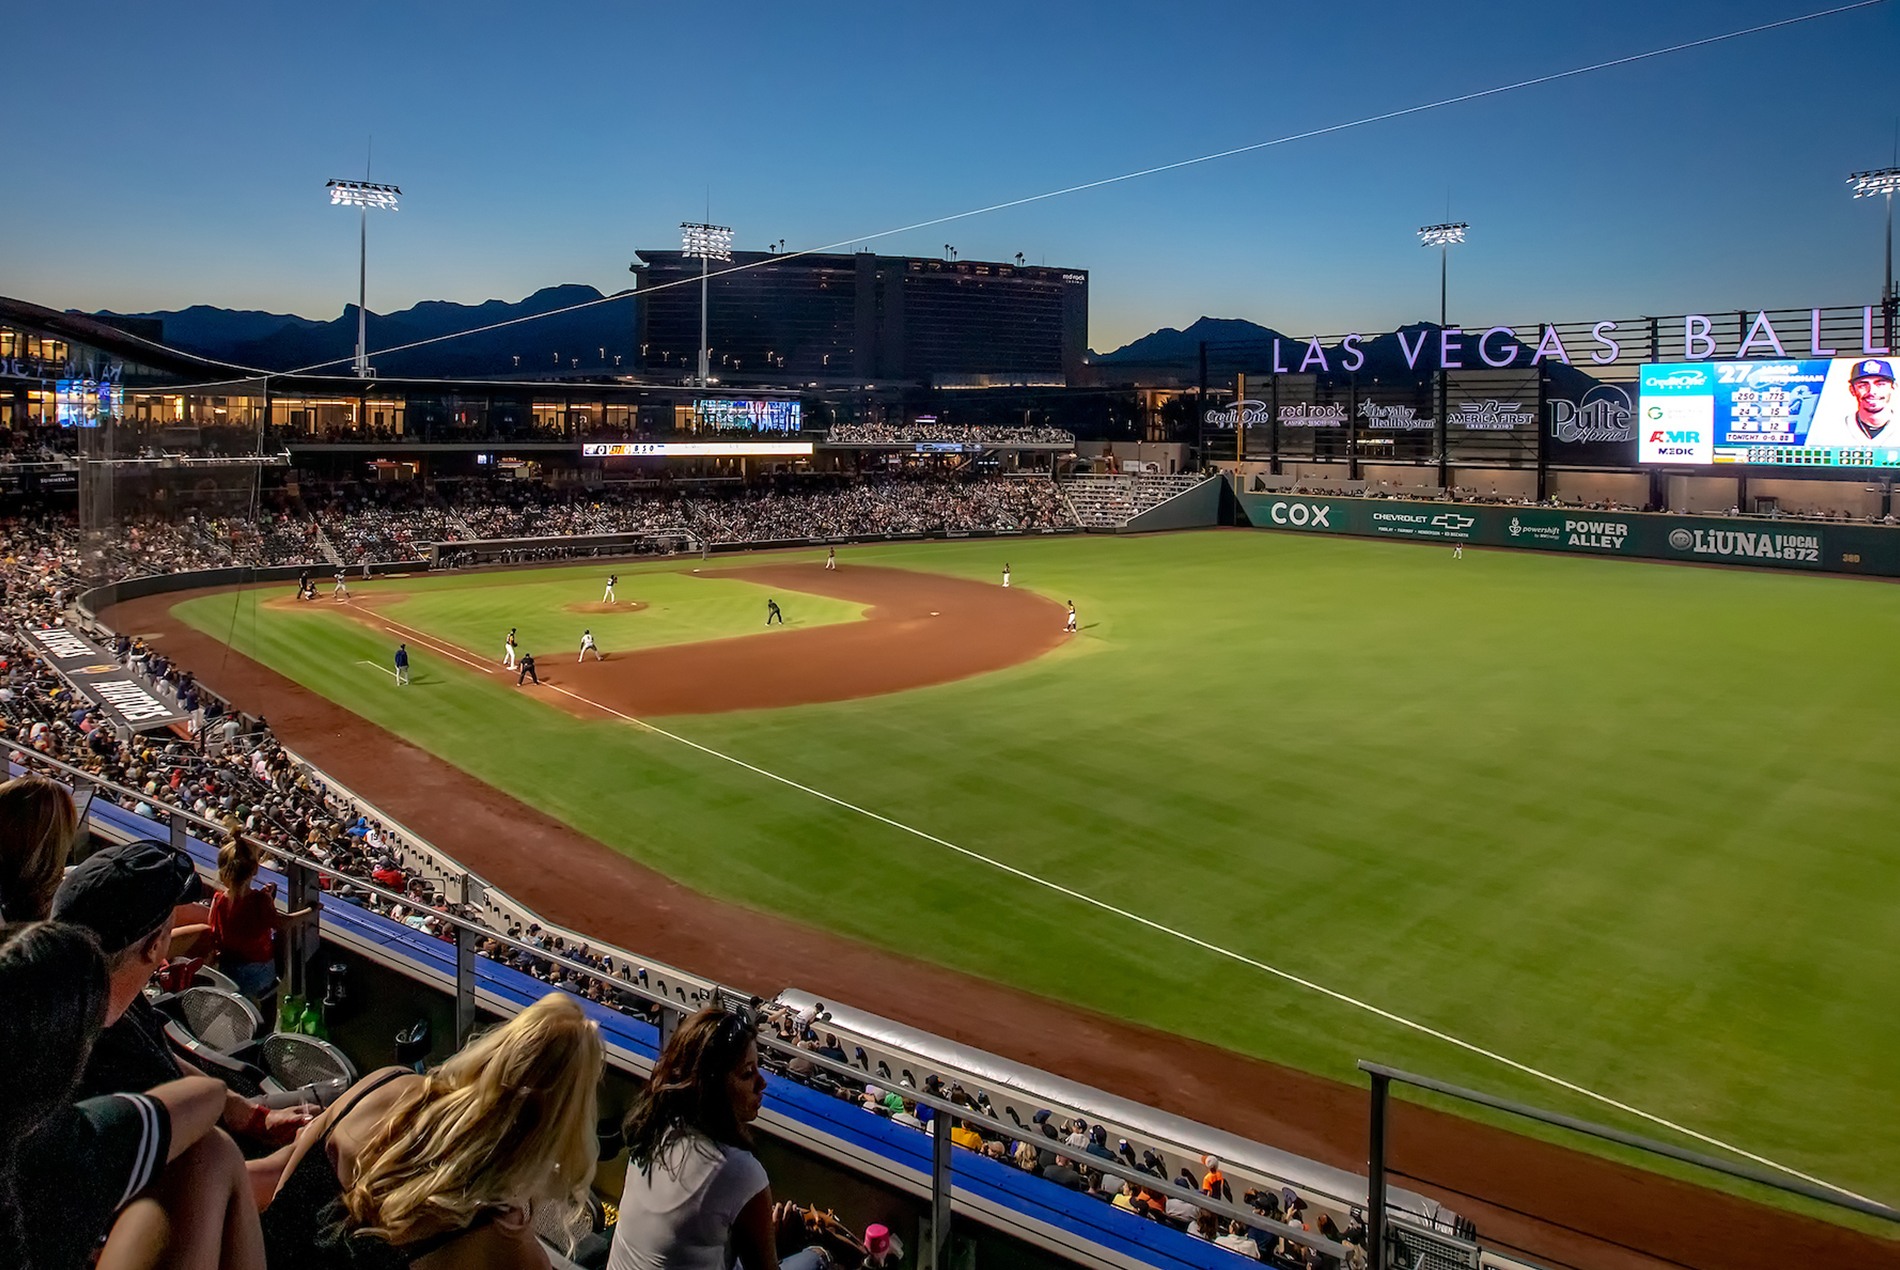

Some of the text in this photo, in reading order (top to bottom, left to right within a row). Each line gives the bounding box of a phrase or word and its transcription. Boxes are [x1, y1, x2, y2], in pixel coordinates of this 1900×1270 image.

[1273, 306, 1890, 373] LAS VEGAS BALL
[1717, 365, 1753, 384] 27
[1735, 392, 1785, 401] .250 .775
[1280, 402, 1345, 418] red rock
[1384, 404, 1417, 420] Valley
[1770, 408, 1780, 416] 15
[1369, 417, 1436, 431] Health System
[1446, 413, 1535, 425] AMERICA FIRST
[1547, 399, 1630, 437] Pulte
[1741, 422, 1780, 430] 2 12
[1571, 427, 1630, 444] Homes
[1649, 430, 1700, 443] AMR
[1270, 501, 1330, 528] COX
[1373, 512, 1428, 523] CHEVROLET
[1522, 526, 1560, 535] powershift
[1564, 520, 1629, 536] POWER
[1568, 534, 1624, 549] ALLEY
[1693, 528, 1783, 559] LiUNA!
[1783, 535, 1819, 549] LOCAL
[1783, 547, 1819, 562] 872
[90, 679, 173, 722] AVIATORS
